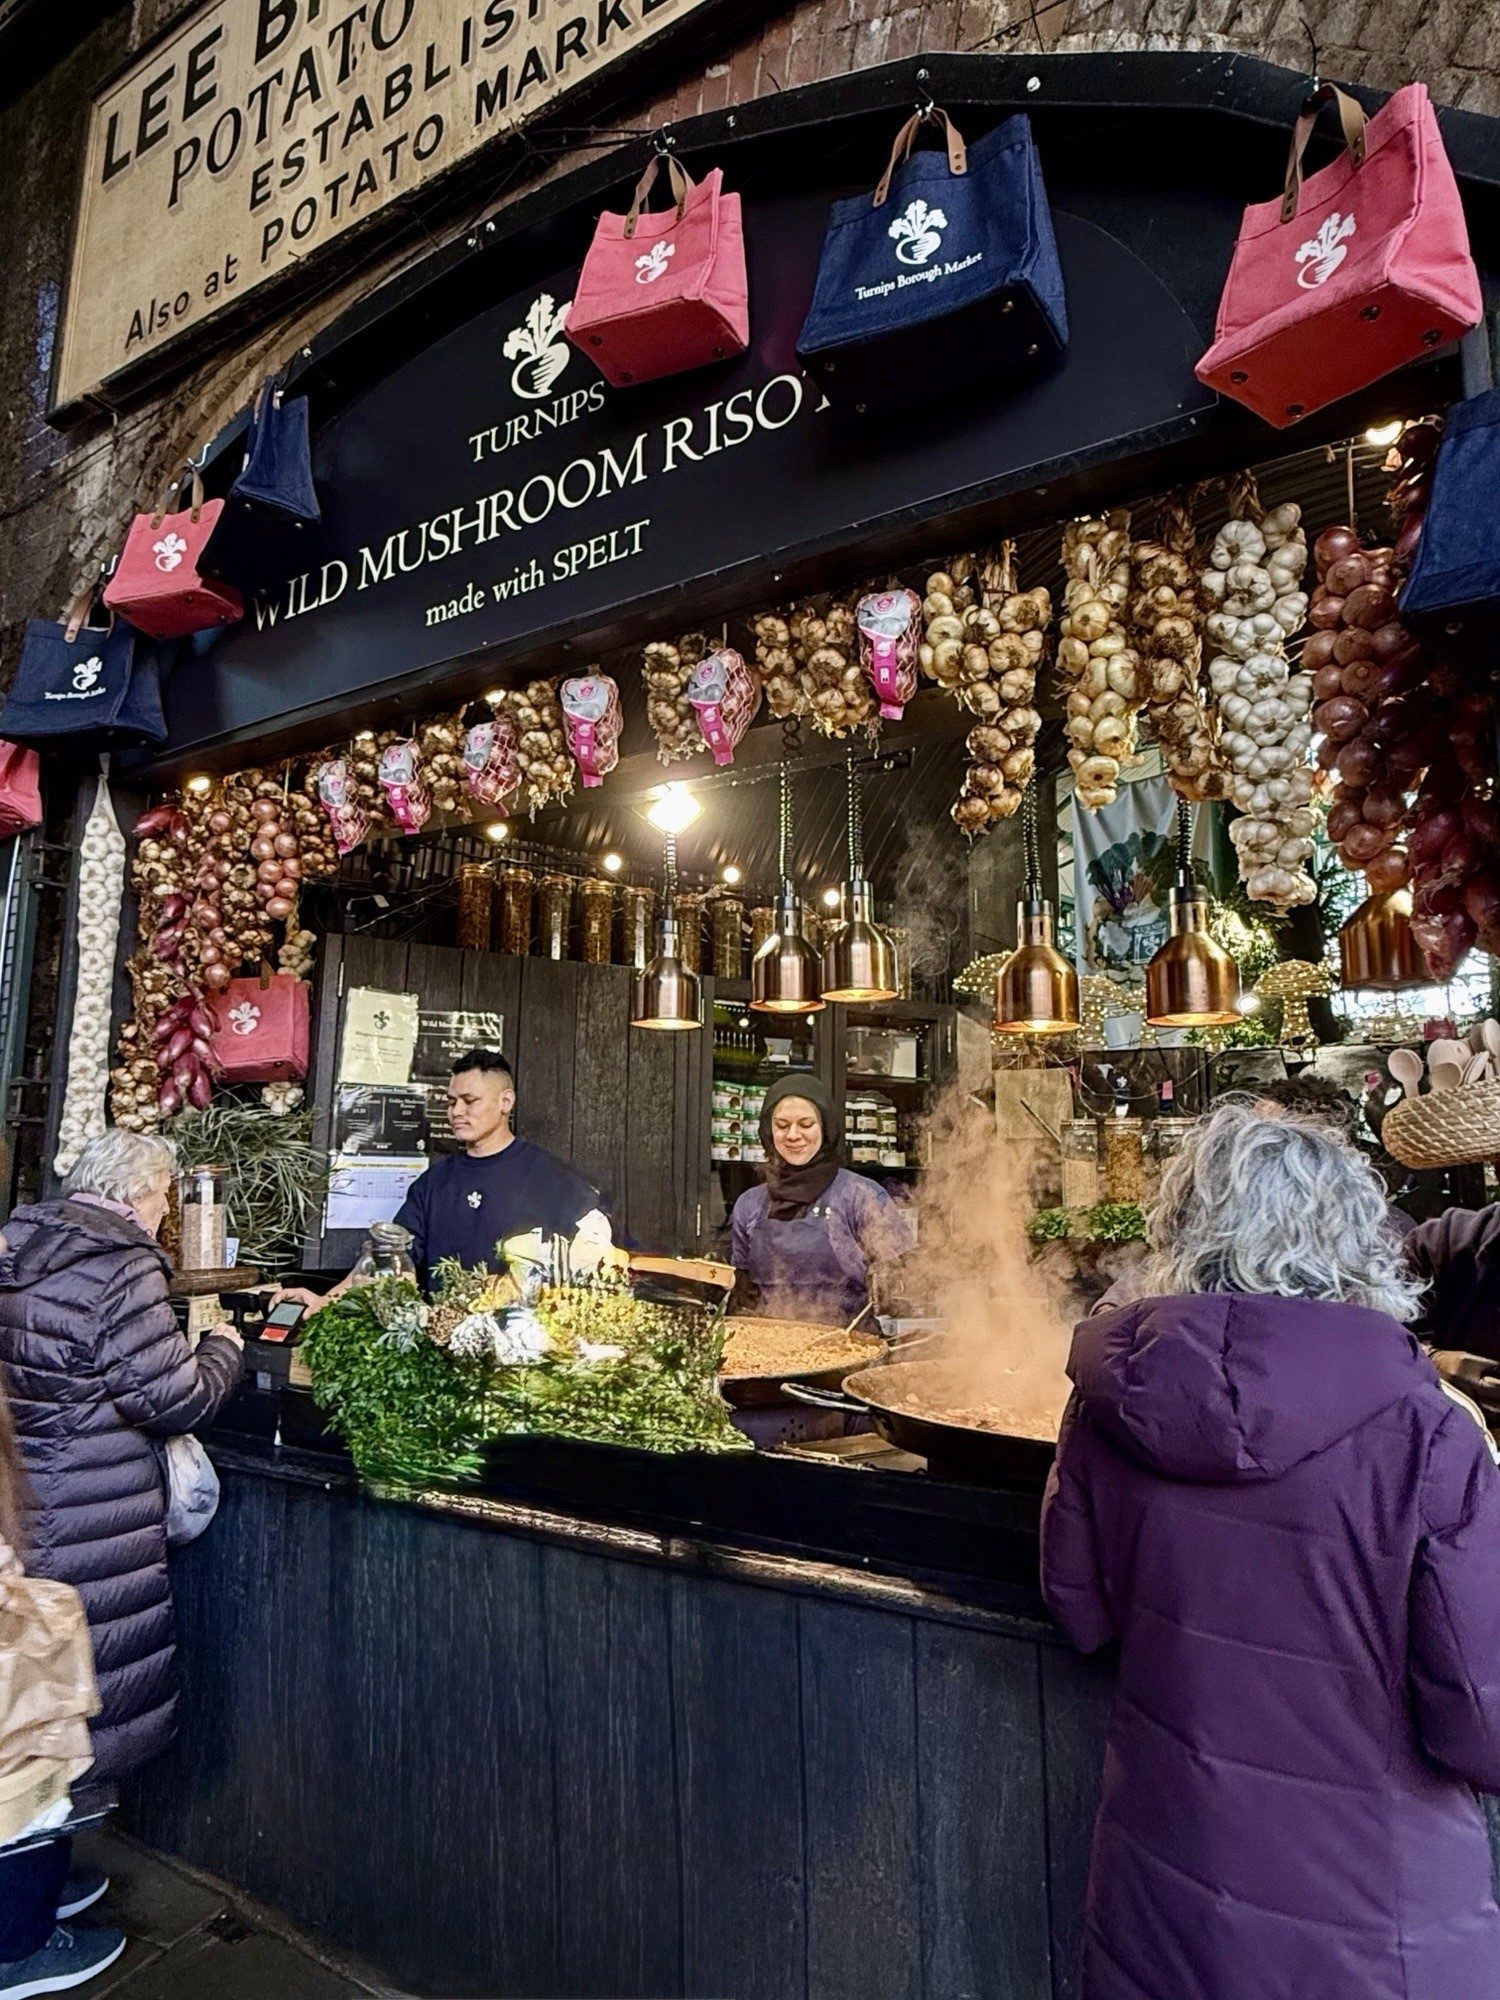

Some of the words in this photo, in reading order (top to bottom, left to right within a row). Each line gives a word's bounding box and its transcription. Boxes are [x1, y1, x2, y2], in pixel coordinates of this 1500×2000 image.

[102, 25, 223, 185] LEE
[254, 0, 320, 66] B
[168, 0, 415, 209] POTATO
[250, 0, 538, 212] ESTABLIS
[124, 291, 190, 350] Also
[204, 254, 238, 298] at
[261, 114, 443, 264] POTATO
[854, 280, 896, 300] Turnips
[897, 265, 942, 288] Borough
[944, 252, 982, 275] Market
[251, 560, 348, 632] WILD
[356, 433, 648, 592] MUSHROOM
[662, 370, 831, 473] RISO
[468, 381, 605, 463] TURNIPS
[425, 581, 485, 627] made
[492, 563, 545, 603] with
[551, 519, 650, 582] SPELT
